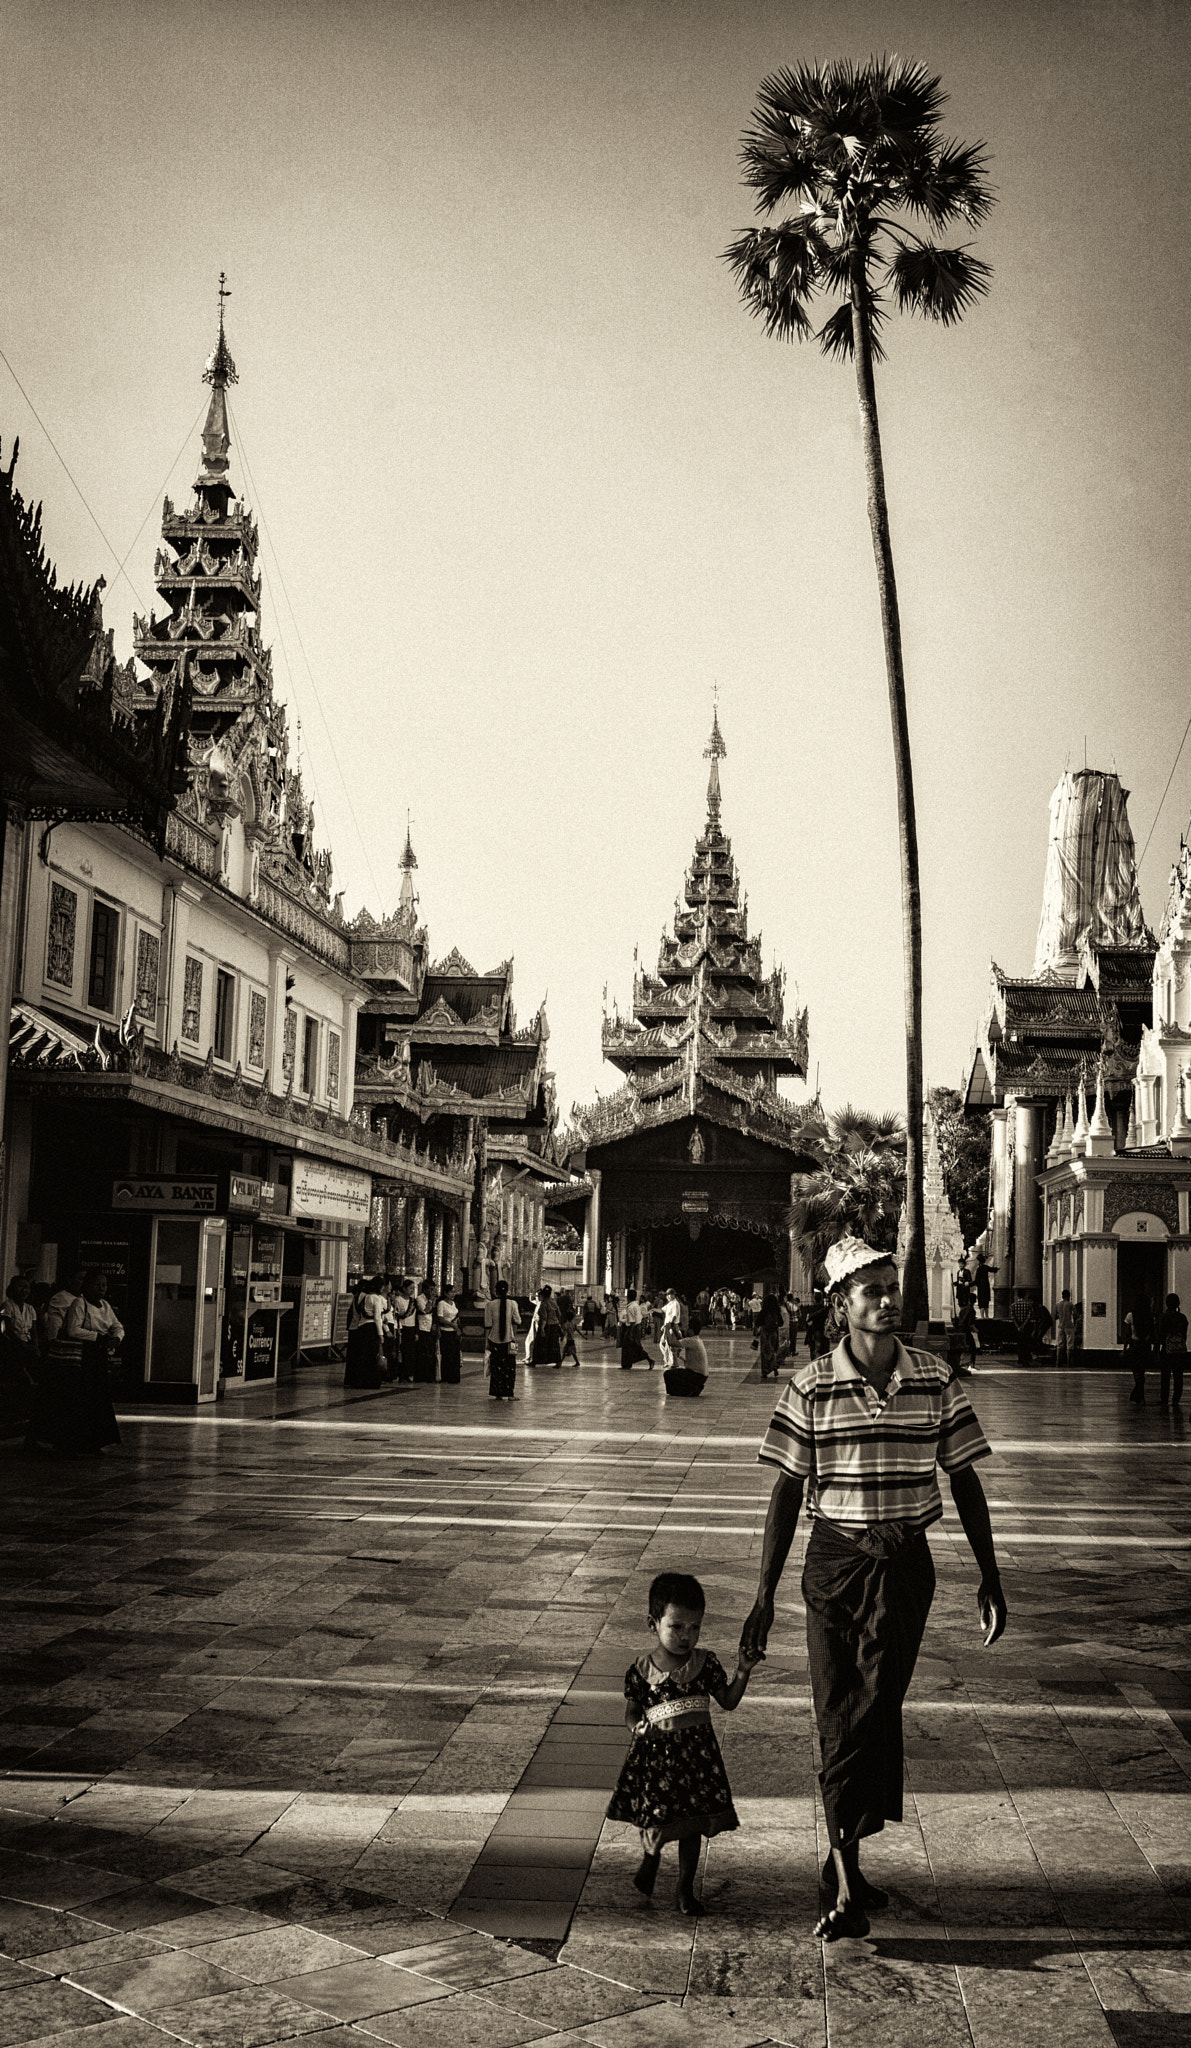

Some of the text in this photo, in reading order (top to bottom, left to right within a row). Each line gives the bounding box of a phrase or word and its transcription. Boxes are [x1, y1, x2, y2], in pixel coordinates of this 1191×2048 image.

[135, 1185, 214, 1200] AYA BANK
[193, 1201, 214, 1209] ATM
[248, 1334, 274, 1351] Currency
[253, 1352, 271, 1365] Exchange
